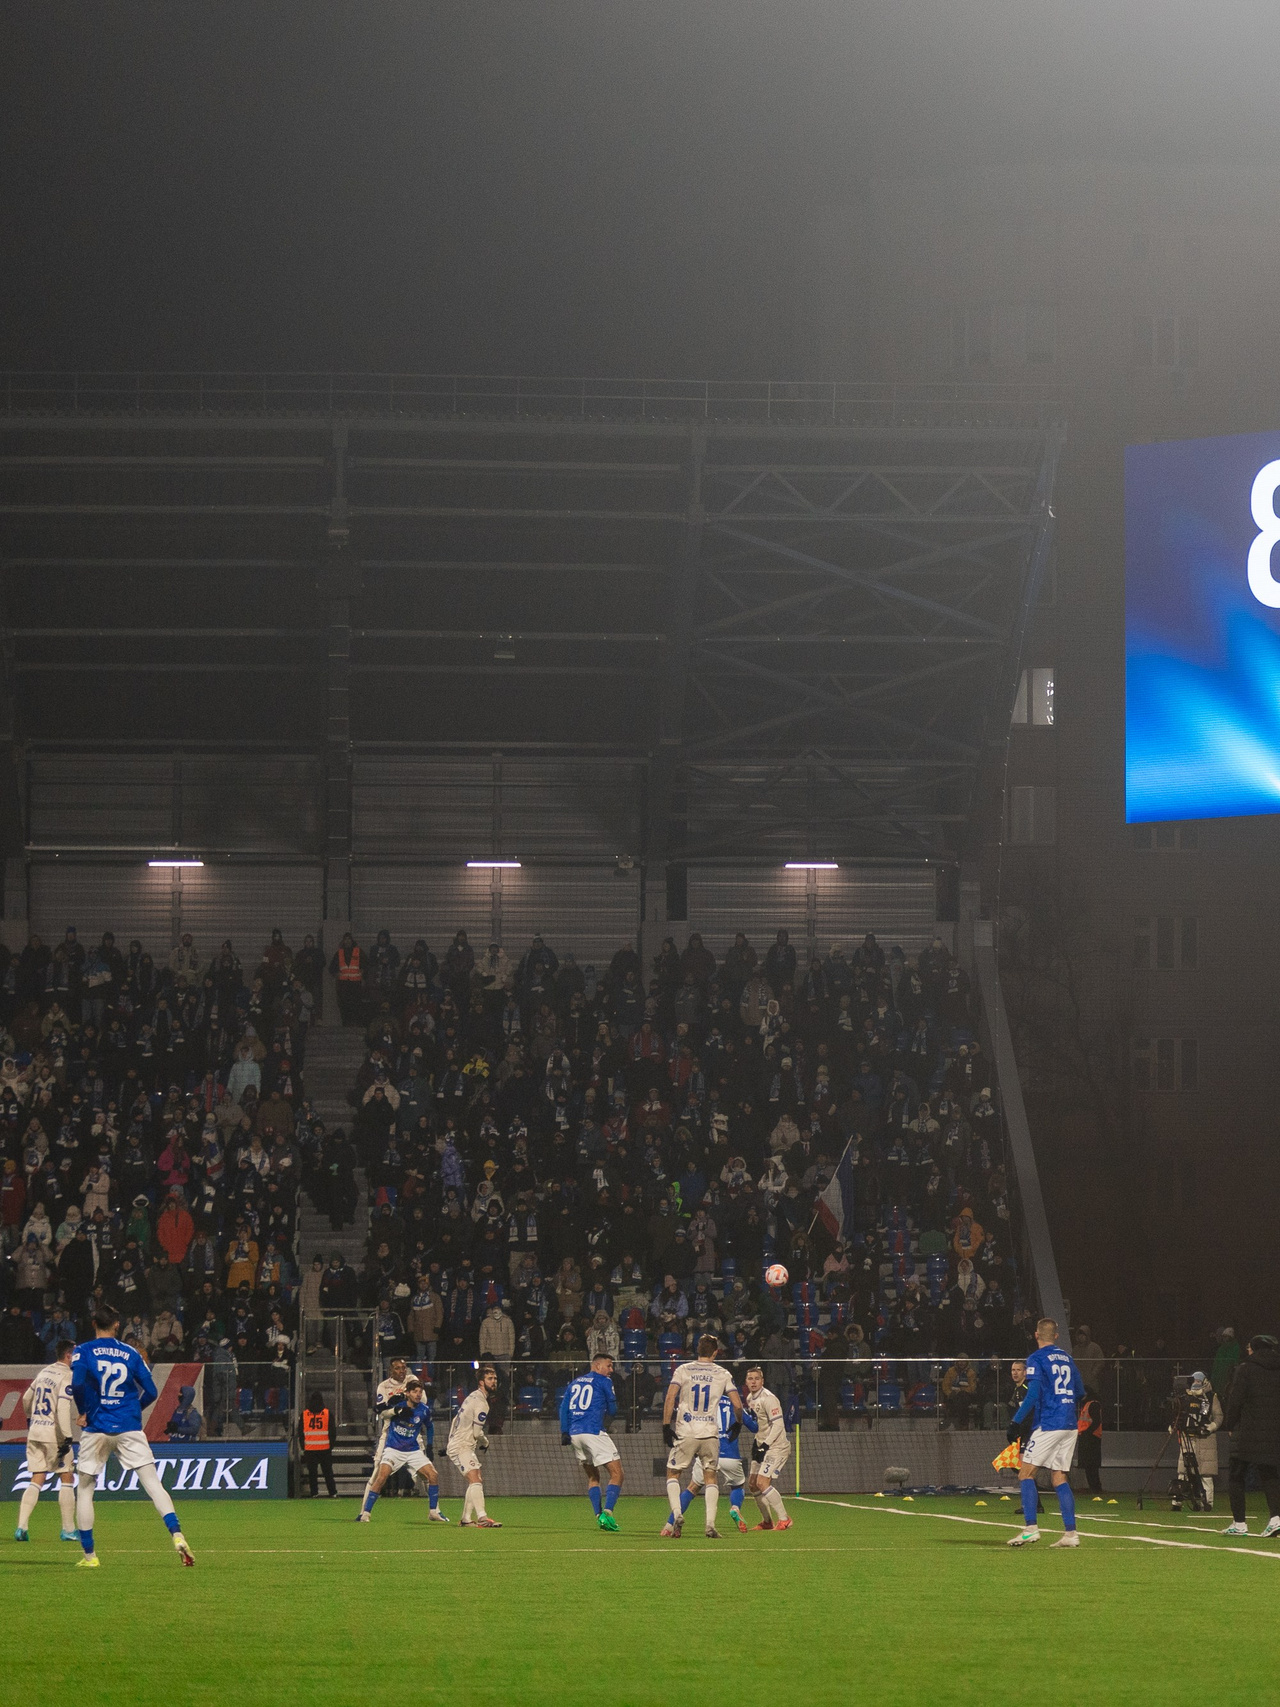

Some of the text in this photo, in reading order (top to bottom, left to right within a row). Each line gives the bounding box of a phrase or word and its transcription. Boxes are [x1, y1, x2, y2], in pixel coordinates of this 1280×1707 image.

[97, 1360, 129, 1398] 72
[1051, 1363, 1074, 1396] 22
[33, 1387, 52, 1416] 25
[569, 1384, 594, 1411] 20
[691, 1383, 711, 1412] 11
[308, 1417, 324, 1430] 45
[763, 1464, 770, 1474] 3
